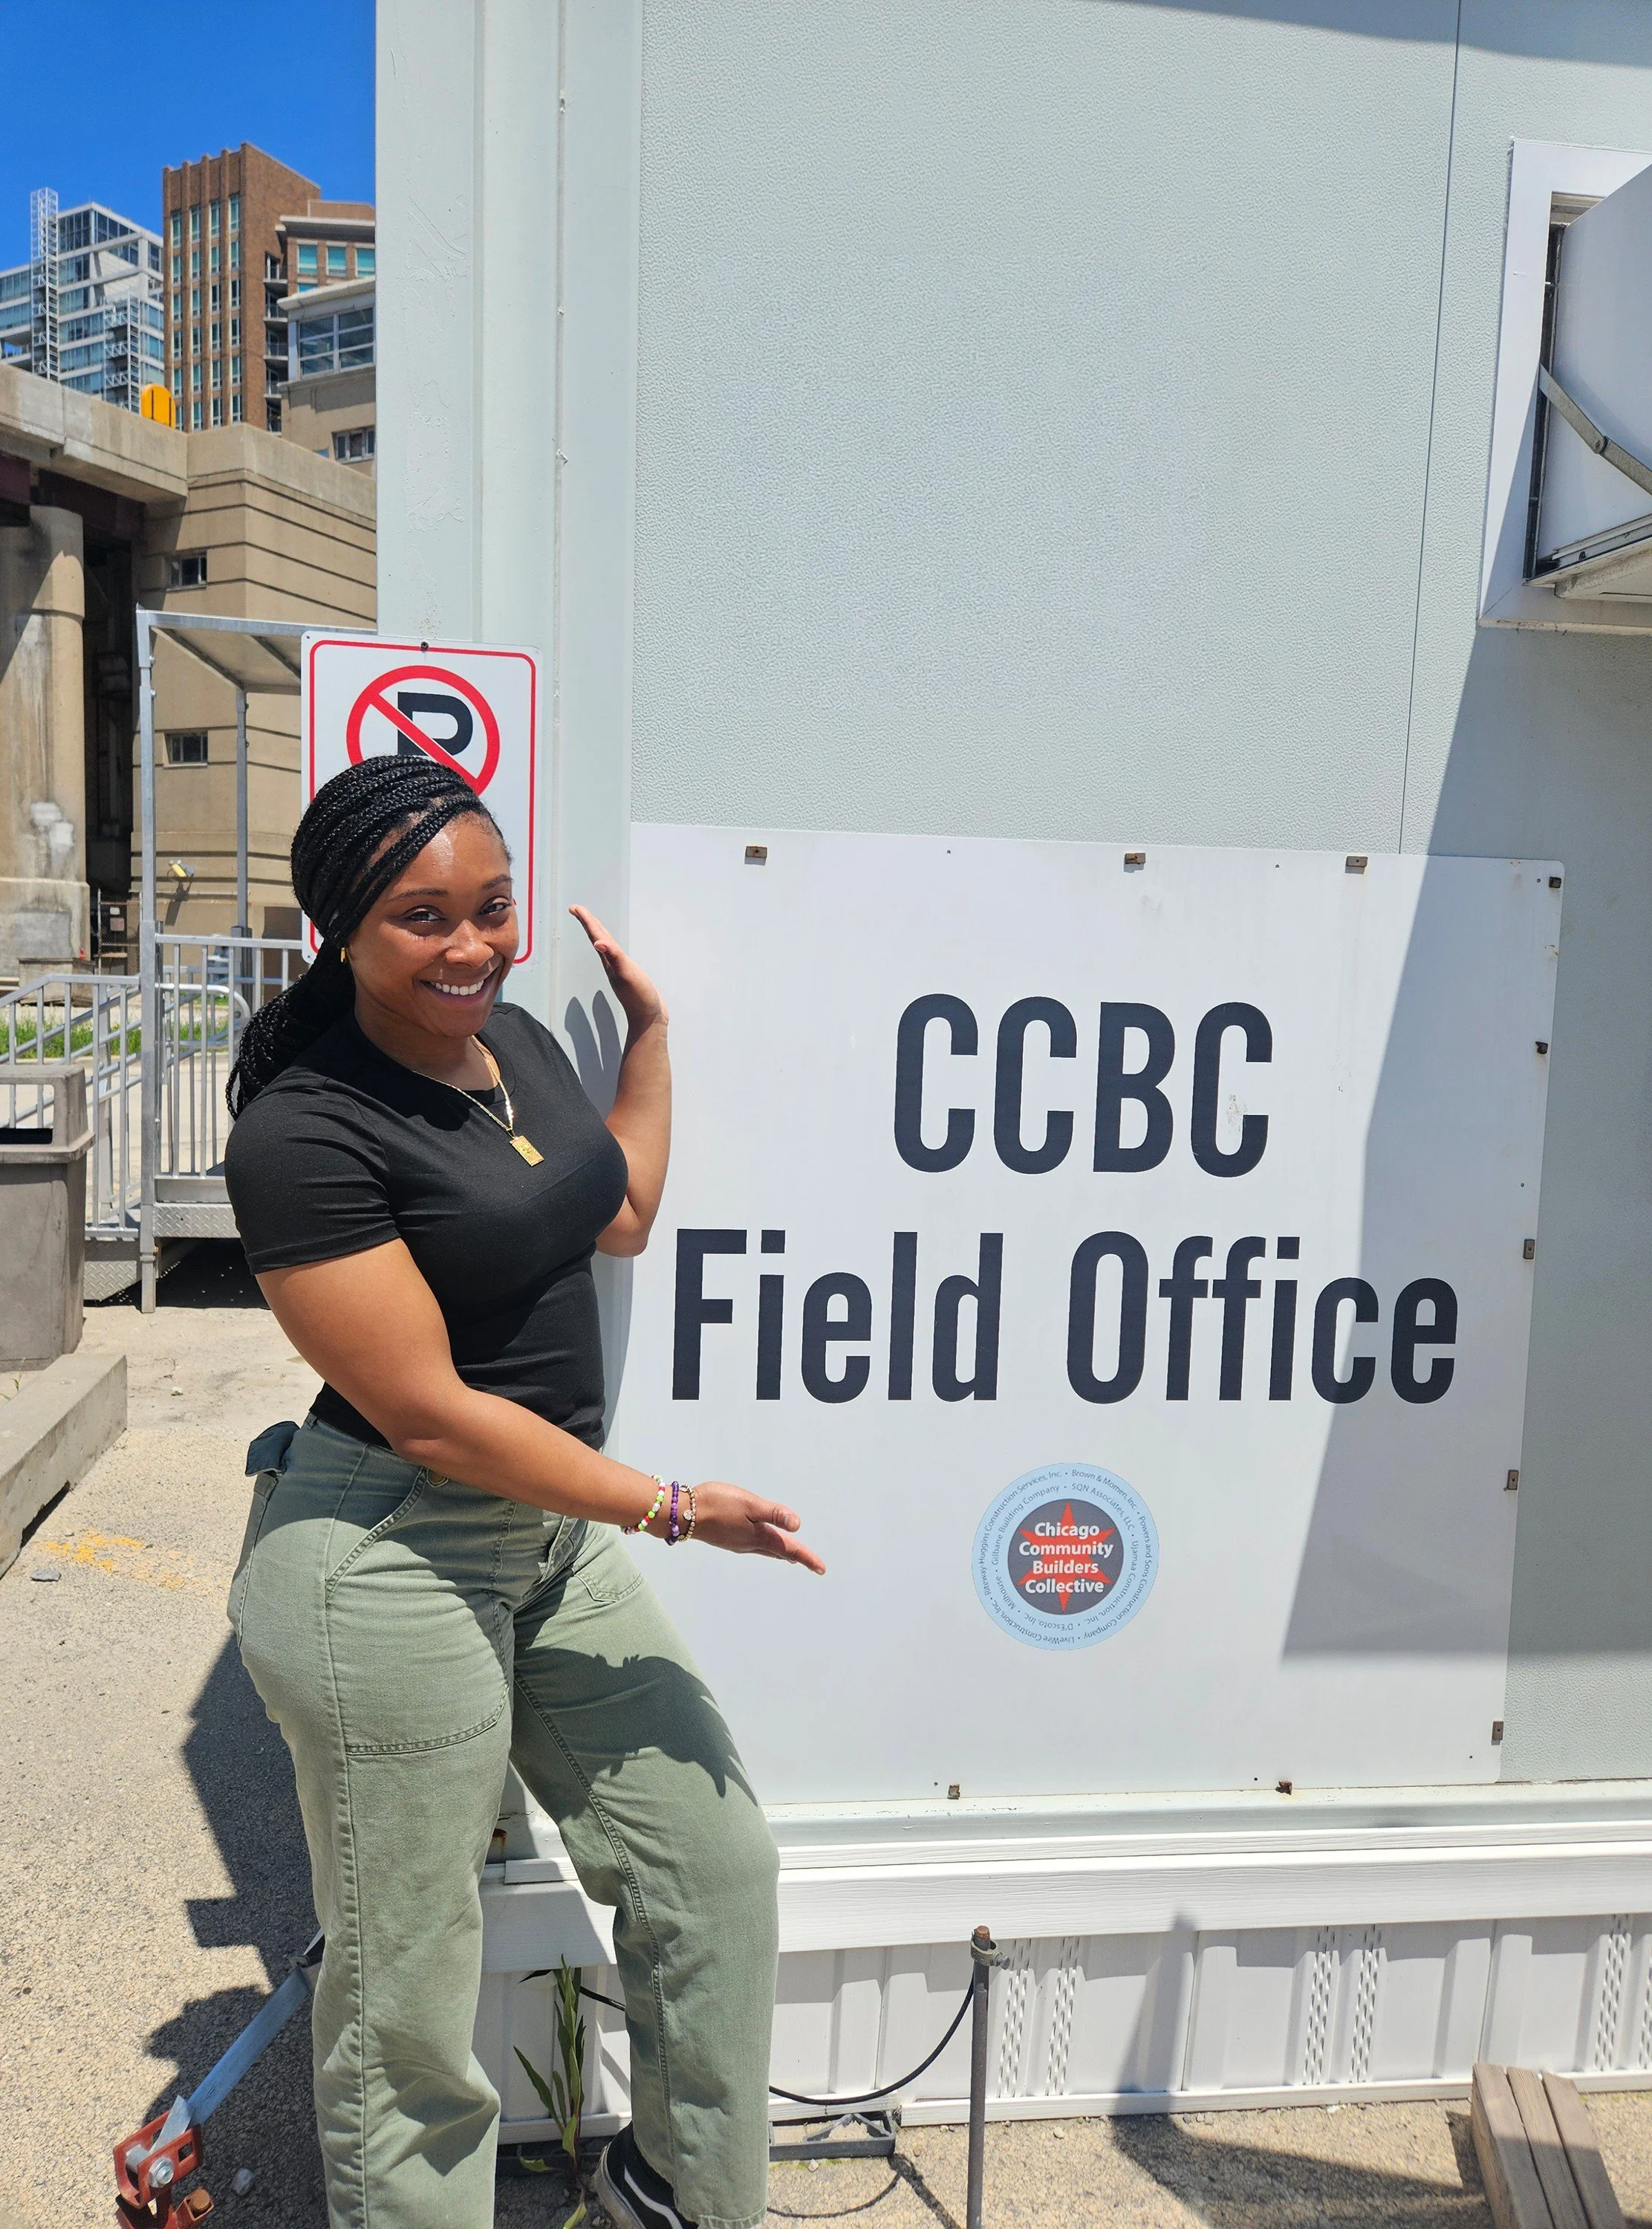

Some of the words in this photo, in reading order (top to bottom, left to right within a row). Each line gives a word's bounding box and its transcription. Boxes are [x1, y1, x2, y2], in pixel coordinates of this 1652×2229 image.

[894, 994, 1272, 1177] CCBC
[673, 1229, 1003, 1403] Field
[1067, 1232, 1457, 1404] Office
[1072, 1470, 1095, 1480] Brown
[1102, 1478, 1128, 1499] Momen,
[985, 1491, 1018, 1531] Construction
[1017, 1475, 1047, 1493] Services,
[1072, 1483, 1089, 1492] SQN
[1090, 1487, 1125, 1517] Associates,
[1123, 1516, 1135, 1531] LLC
[992, 1534, 1003, 1565] Gilbane
[998, 1503, 1024, 1533] Building
[1022, 1485, 1060, 1505] Company
[1035, 1522, 1100, 1539] Chicago
[1139, 1516, 1150, 1542] Powers
[1018, 1541, 1113, 1558] Community
[1131, 1540, 1139, 1571] Ujamaa
[1032, 1560, 1099, 1574] Builders
[1142, 1560, 1152, 1577] Sons
[996, 1576, 1016, 1609] Milhouse
[1025, 1578, 1104, 1593] Collective
[1098, 1573, 1136, 1616] Construction,
[1116, 1579, 1147, 1620] Construction
[1001, 1611, 1041, 1641] Construction,
[1024, 1613, 1036, 1625] Inc.
[1038, 1619, 1073, 1631] D'Escoto,
[1084, 1615, 1099, 1624] Inc.
[1084, 1619, 1117, 1639] Company
[1043, 1635, 1074, 1644] LiveWire
